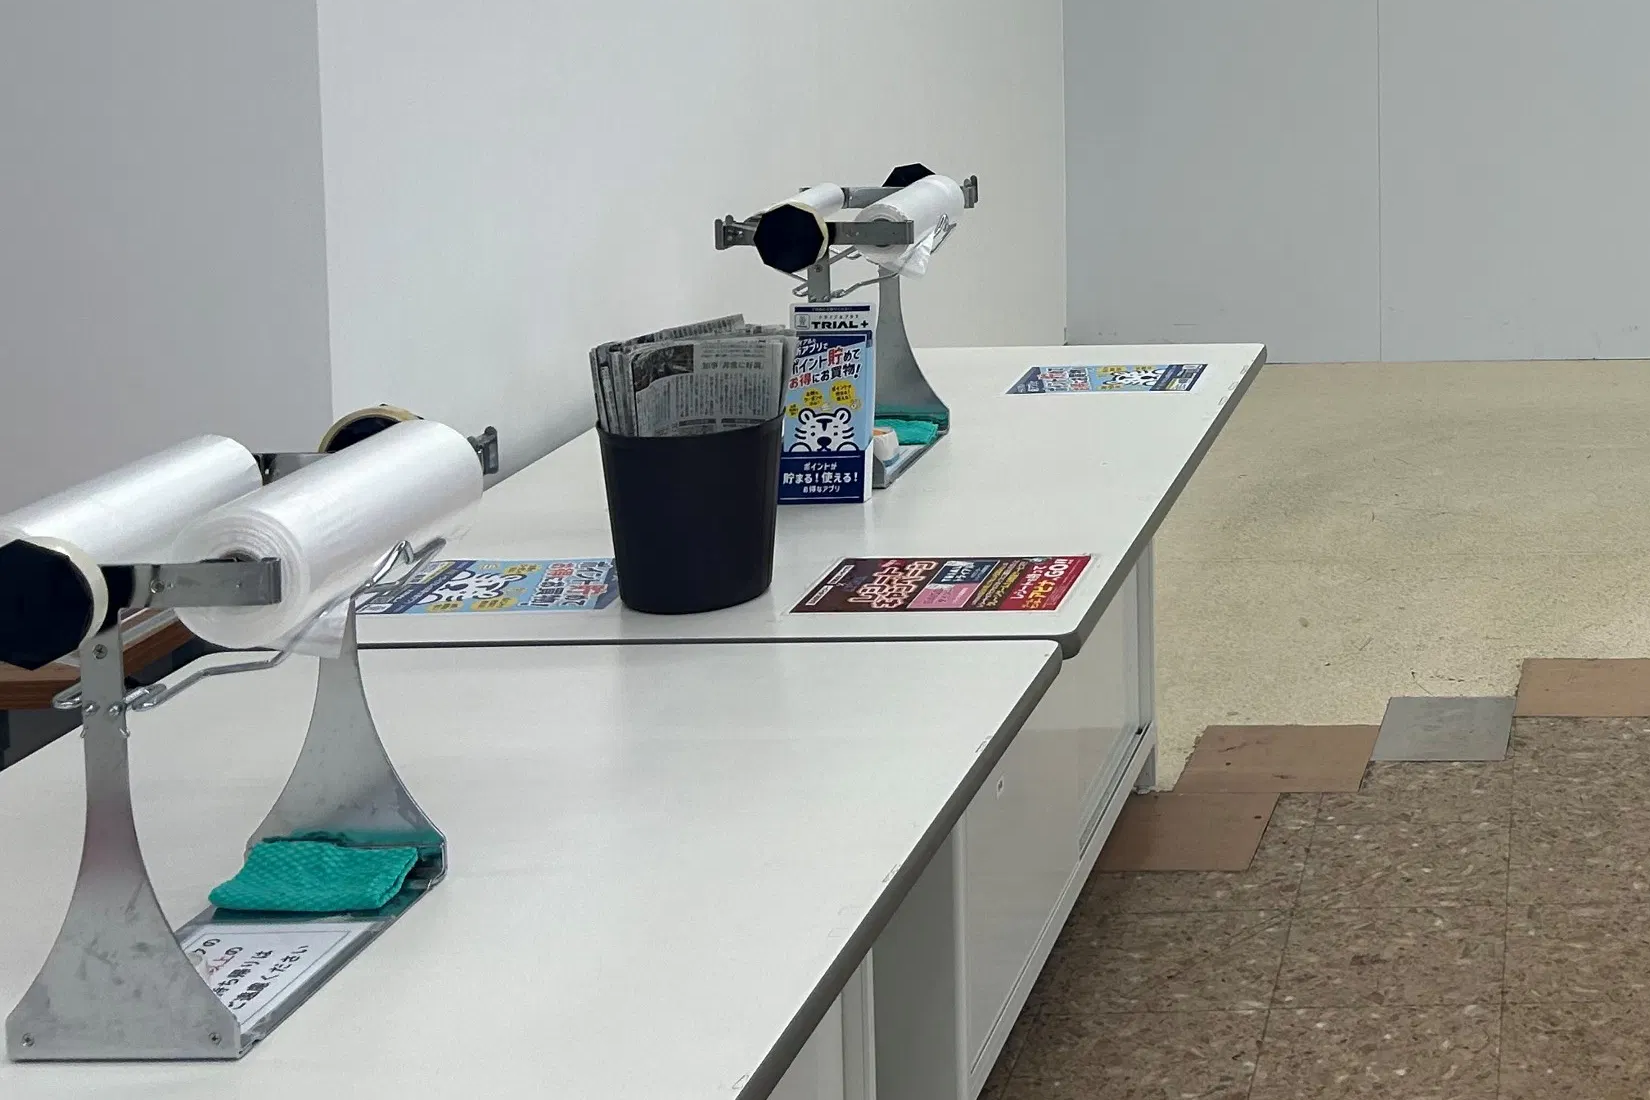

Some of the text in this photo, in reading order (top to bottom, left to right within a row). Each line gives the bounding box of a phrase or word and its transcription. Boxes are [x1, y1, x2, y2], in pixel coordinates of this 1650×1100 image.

[789, 364, 861, 389] お得にお買物!
[804, 462, 837, 471] ポイントが
[803, 485, 840, 493] お得なアプリ
